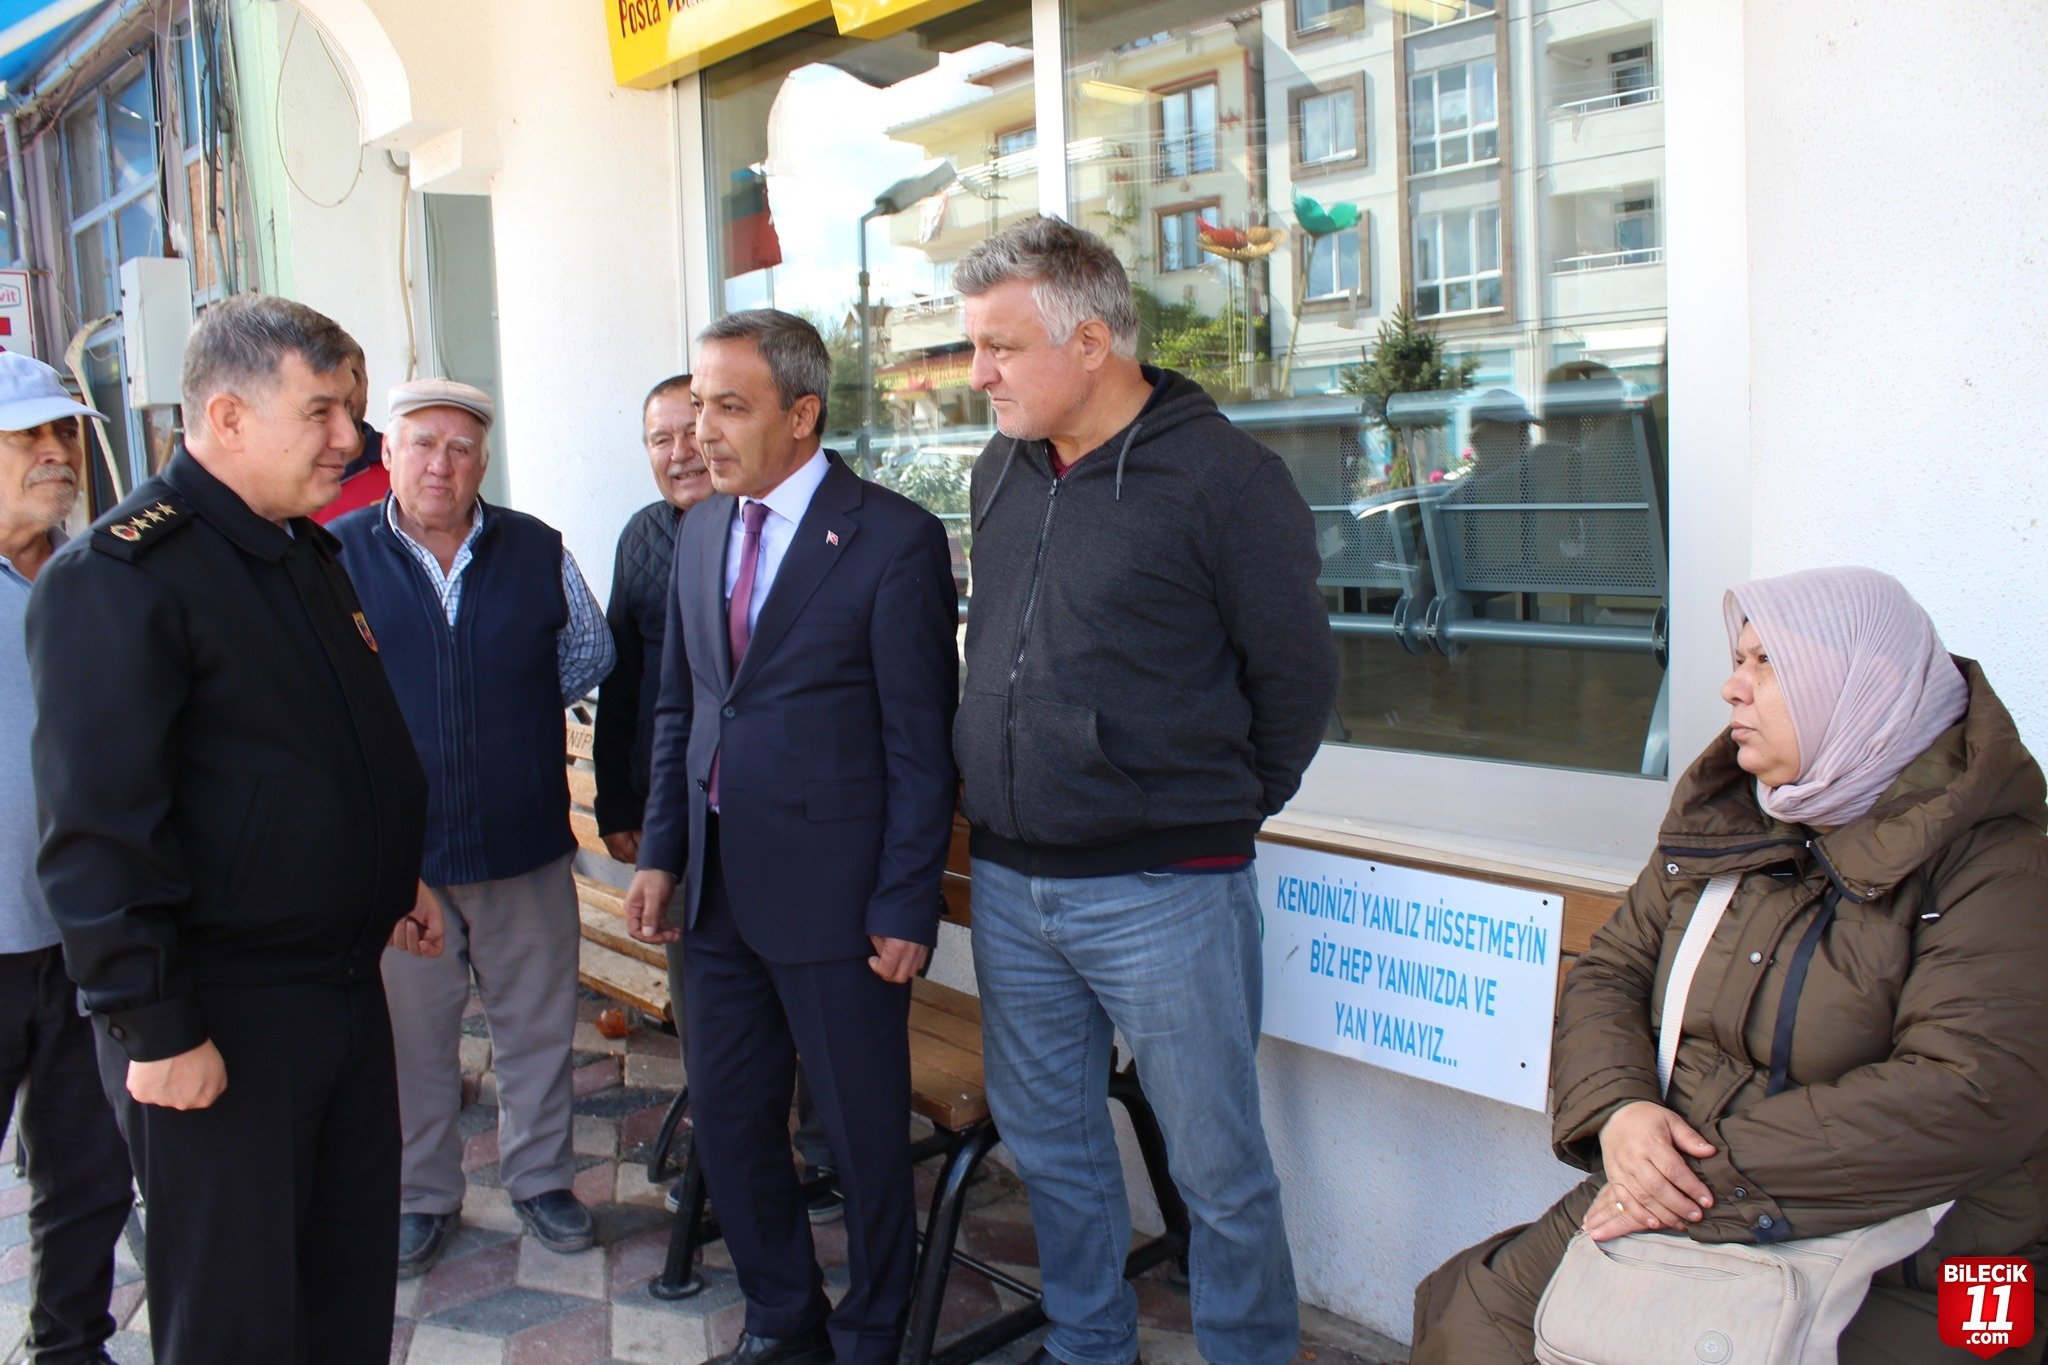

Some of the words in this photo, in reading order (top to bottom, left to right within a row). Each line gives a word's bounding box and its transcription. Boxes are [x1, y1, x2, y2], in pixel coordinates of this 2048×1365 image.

[1276, 875, 1358, 925] KENDİNİZİ
[1361, 892, 1422, 938] YANLIZ
[1424, 898, 1548, 966] HİSSETMEYİN
[1310, 932, 1337, 978] BİZ
[1339, 945, 1373, 985] HEP
[1377, 953, 1469, 1011] YANINIZDA
[1475, 976, 1497, 1016] VE
[1335, 1001, 1368, 1043] YAN
[1372, 1010, 1458, 1068] YANAYIZ...
